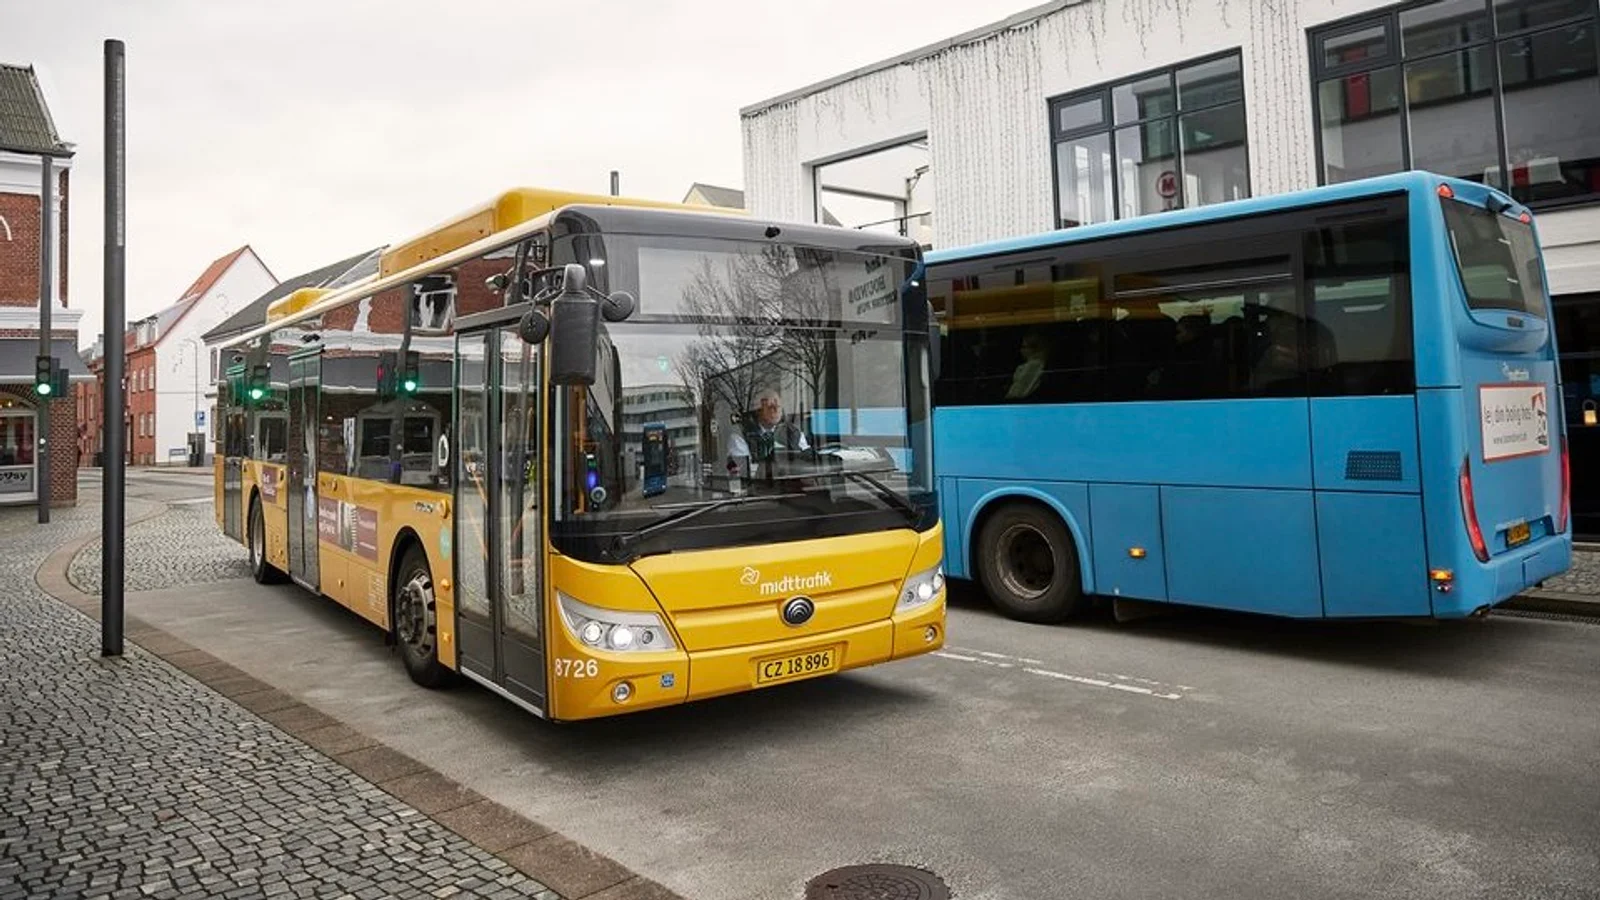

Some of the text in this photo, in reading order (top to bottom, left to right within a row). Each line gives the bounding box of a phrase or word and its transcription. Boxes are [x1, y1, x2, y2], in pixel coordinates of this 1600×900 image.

[760, 571, 832, 595] midttrafik
[555, 658, 599, 678] 8726
[764, 652, 830, 678] CZ 18 896
